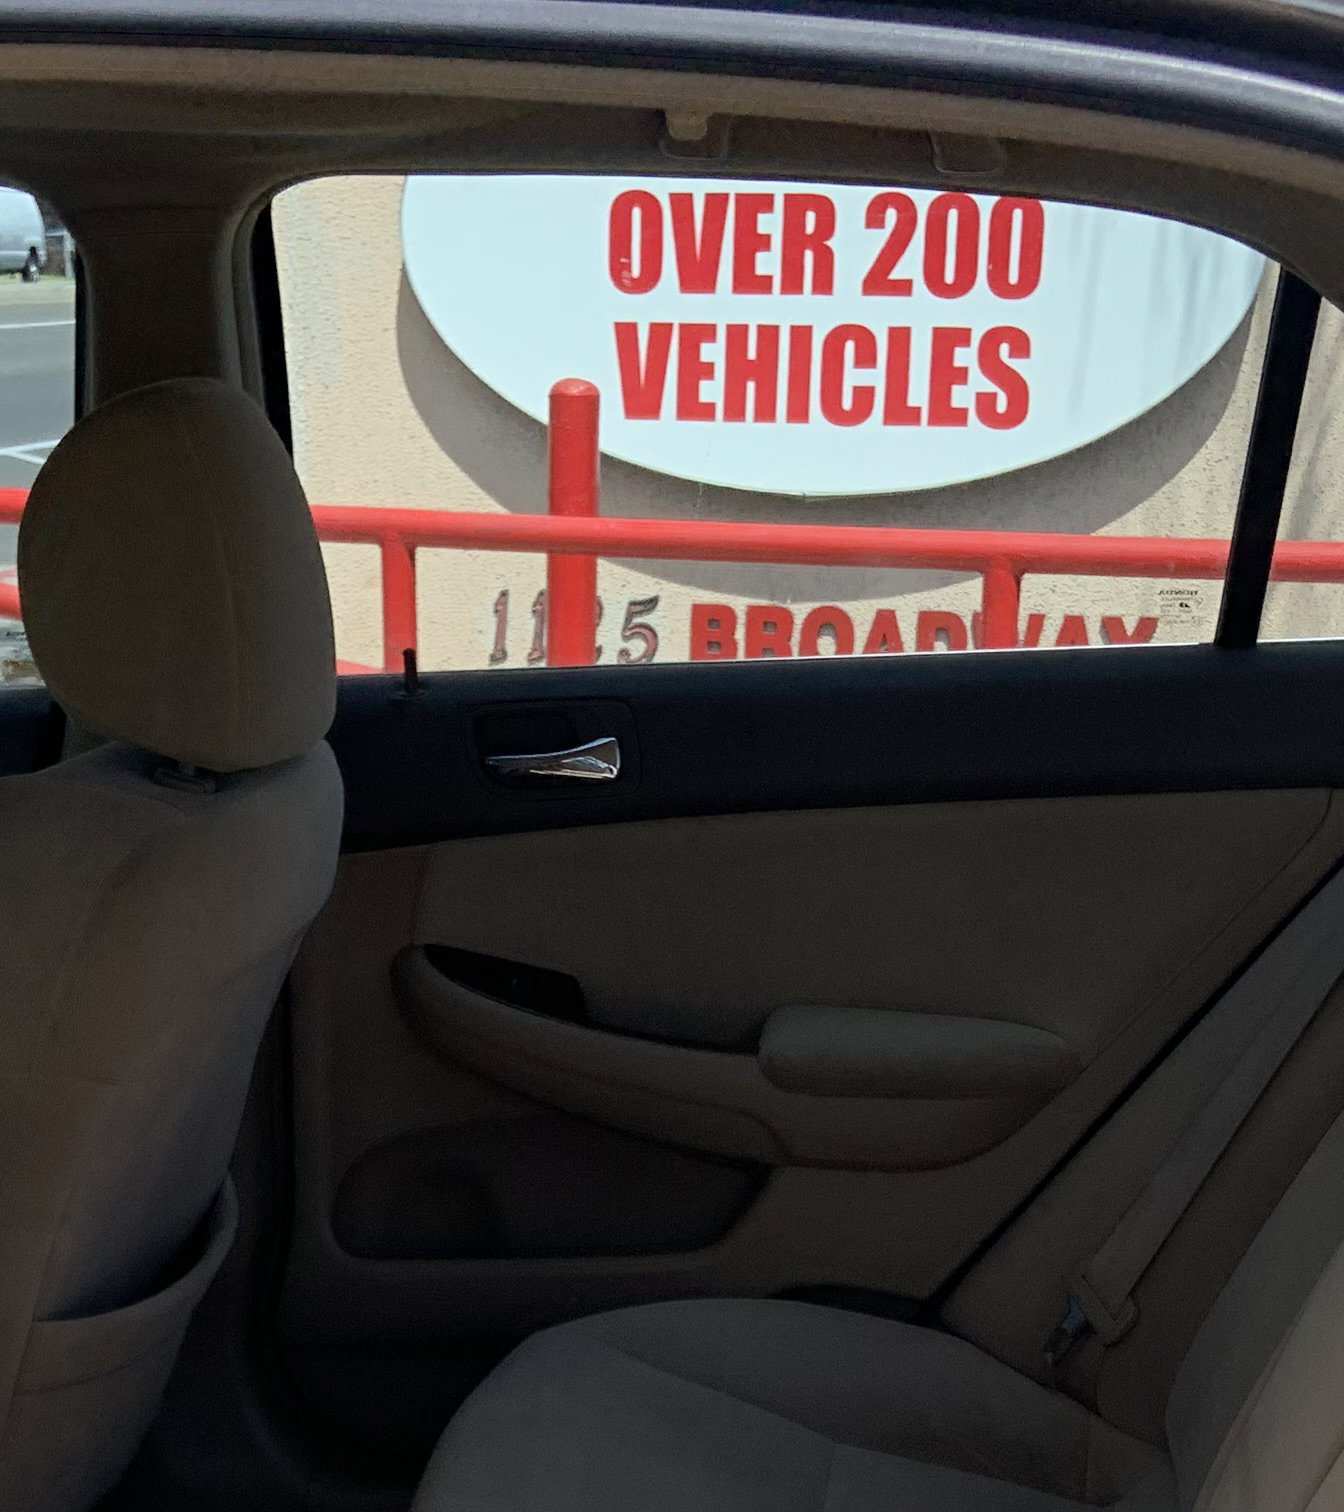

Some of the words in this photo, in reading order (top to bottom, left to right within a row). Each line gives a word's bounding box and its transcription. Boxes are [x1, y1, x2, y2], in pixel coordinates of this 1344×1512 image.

[608, 189, 837, 296] OVER
[861, 190, 1045, 300] 200
[613, 321, 1032, 431] VEHICLES
[488, 588, 660, 667] 115
